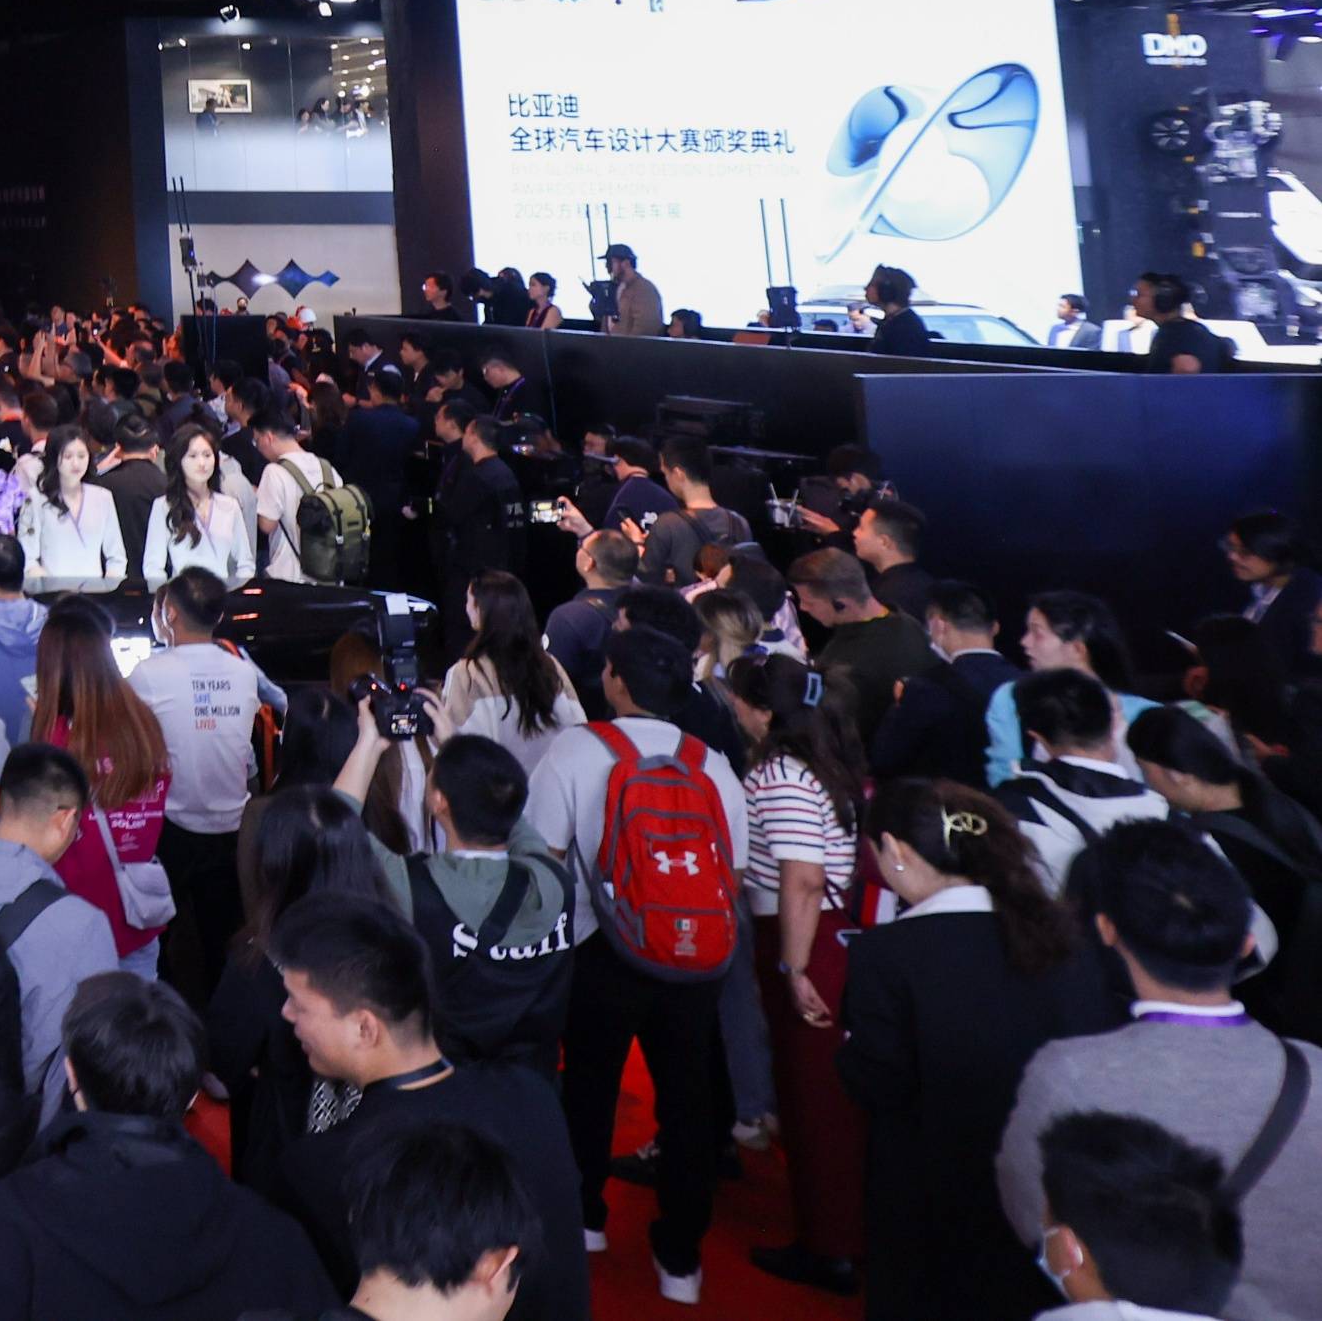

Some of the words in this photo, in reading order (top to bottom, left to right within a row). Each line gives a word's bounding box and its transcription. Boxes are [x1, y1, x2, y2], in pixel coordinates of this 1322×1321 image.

[508, 93, 580, 118] 比亚迪
[510, 126, 795, 154] 全球汽车设计大赛颁奖典礼
